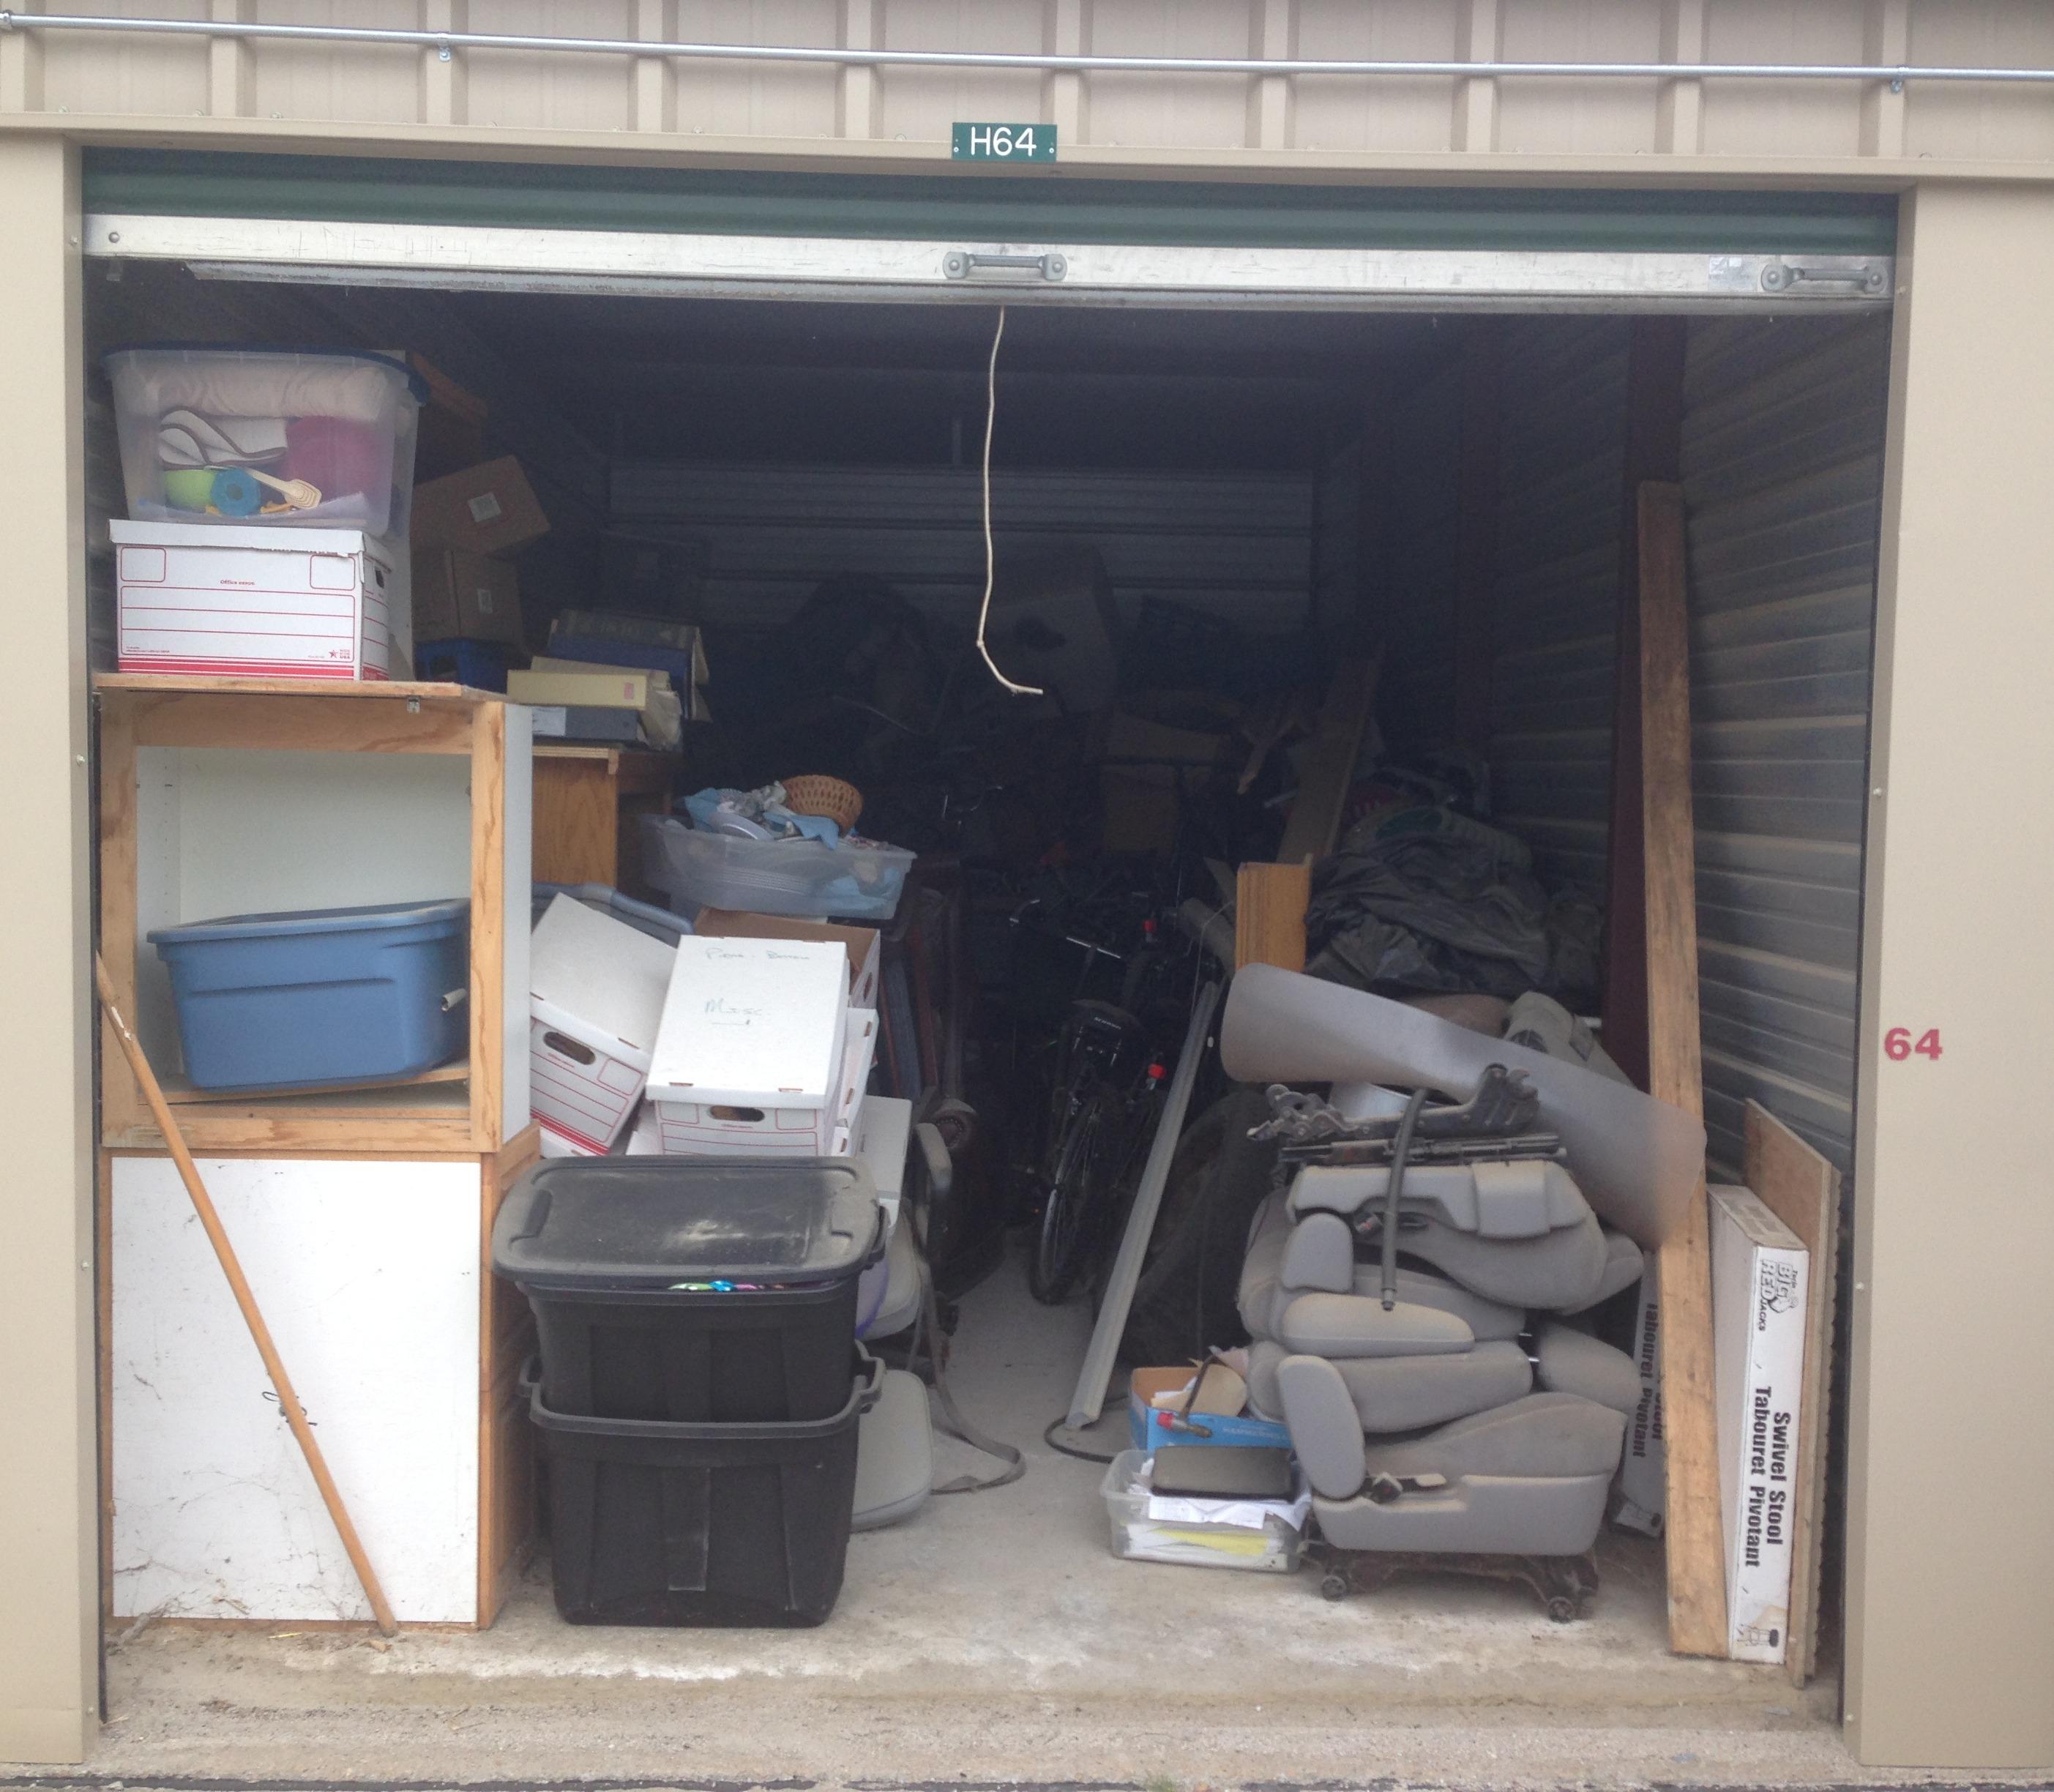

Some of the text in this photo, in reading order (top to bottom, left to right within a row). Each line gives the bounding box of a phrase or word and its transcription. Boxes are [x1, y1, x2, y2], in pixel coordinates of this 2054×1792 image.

[971, 127, 1037, 157] H64
[1884, 1027, 1943, 1061] 64
[1758, 1259, 1777, 1332] RED JACKS
[1777, 1261, 1793, 1298] BIG
[1745, 1386, 1772, 1567] Tabouret Pivotant
[1766, 1411, 1791, 1545] Swivel Stool
